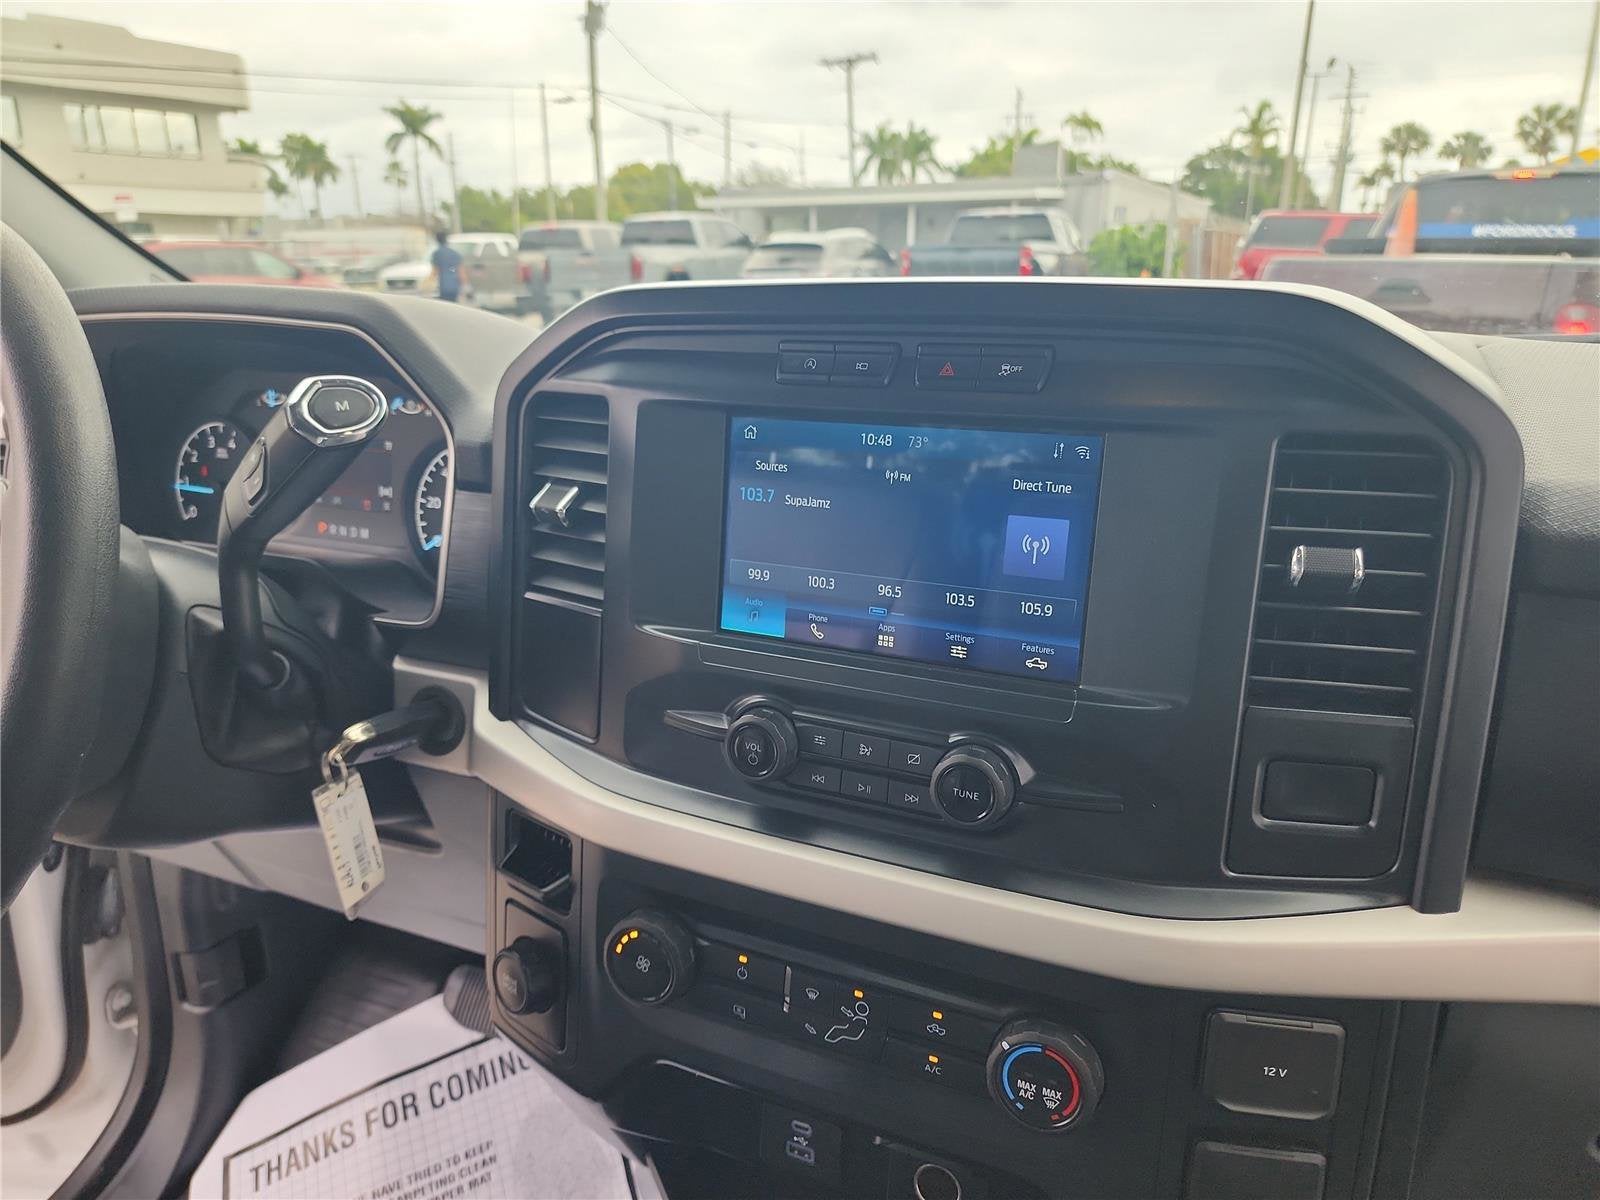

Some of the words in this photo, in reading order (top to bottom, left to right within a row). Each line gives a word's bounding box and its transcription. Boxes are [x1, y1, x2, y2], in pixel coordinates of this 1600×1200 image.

[1010, 365, 1023, 373] OFF
[335, 401, 350, 412] M
[861, 433, 893, 447] 10:48
[908, 436, 929, 448] 73°
[755, 460, 788, 473] Sources
[900, 474, 911, 482] FM
[1012, 479, 1042, 492] Direct
[1045, 481, 1072, 495] Tune
[740, 487, 775, 503] 103.7
[785, 494, 831, 509] SupaJamz
[748, 568, 770, 581] 99.9
[808, 576, 835, 590] 100.3
[877, 584, 902, 598] 96.5
[945, 592, 975, 607] 103.5
[1020, 601, 1053, 617] 105.9
[745, 597, 763, 607] Audio
[808, 613, 828, 623] Phone
[878, 623, 896, 633] Apps
[945, 632, 975, 645] Settings
[1021, 642, 1055, 655] Features
[745, 742, 762, 752] VOL
[952, 787, 980, 801] TUNE
[924, 1063, 942, 1076] A/C
[1263, 1066, 1276, 1077] 12
[1278, 1068, 1287, 1078] V
[1017, 1079, 1037, 1092] MAX
[1019, 1089, 1035, 1100] A/C
[1042, 1087, 1062, 1100] MAX
[249, 1121, 356, 1193] THANKS
[366, 1092, 420, 1138] FOR
